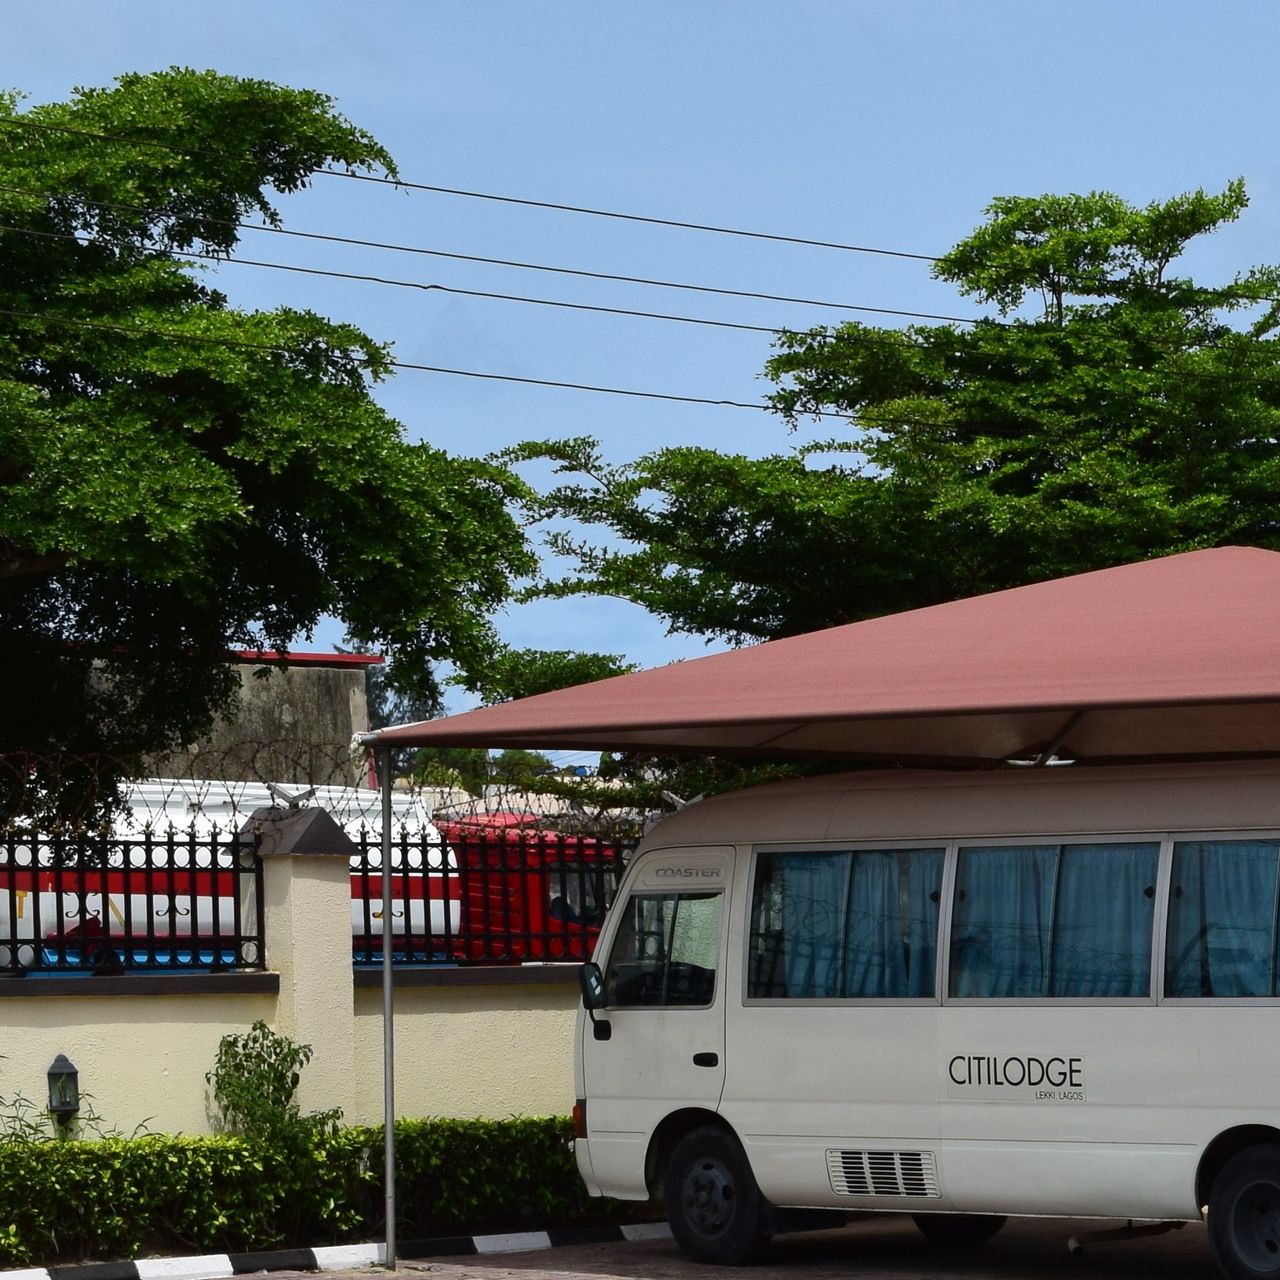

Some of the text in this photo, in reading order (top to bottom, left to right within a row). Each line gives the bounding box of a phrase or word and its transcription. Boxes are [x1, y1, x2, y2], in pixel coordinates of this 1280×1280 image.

[655, 867, 721, 878] COASTER
[949, 1055, 1083, 1087] CITILODGE
[1059, 1091, 1084, 1101] LAGOS
